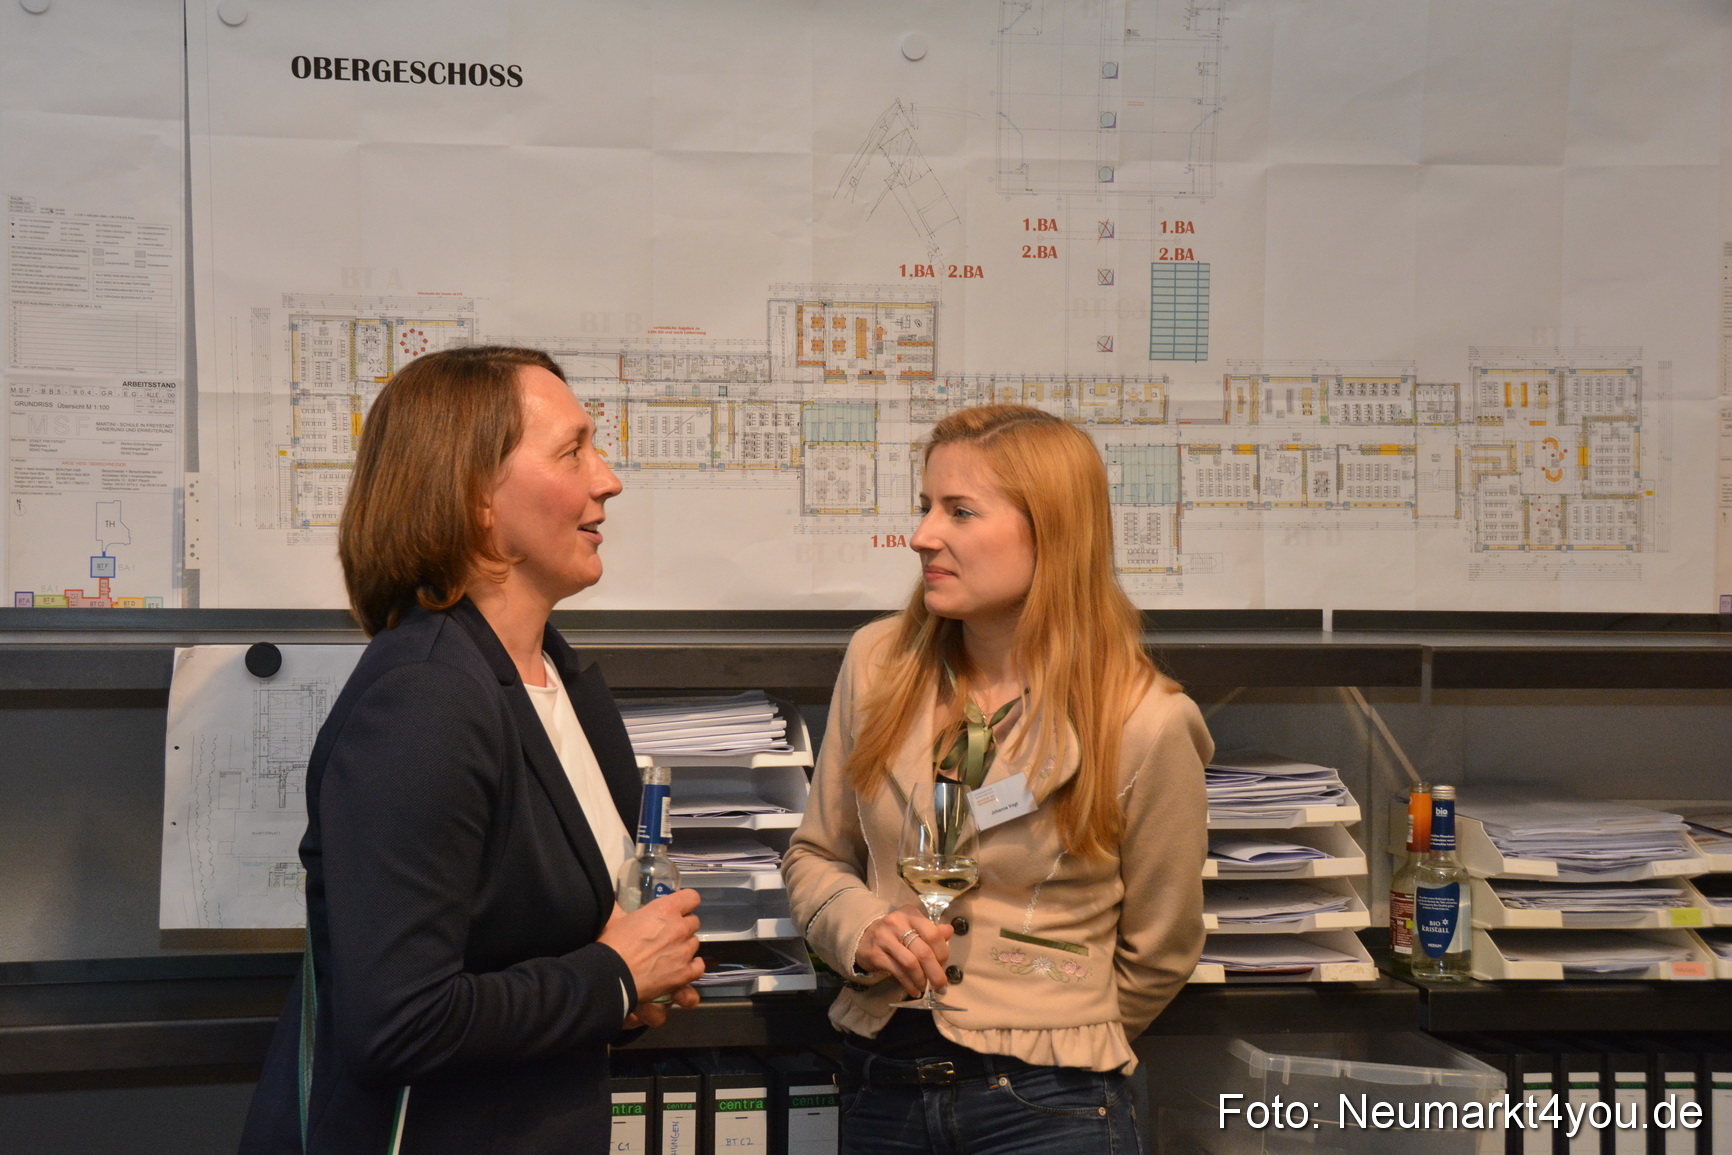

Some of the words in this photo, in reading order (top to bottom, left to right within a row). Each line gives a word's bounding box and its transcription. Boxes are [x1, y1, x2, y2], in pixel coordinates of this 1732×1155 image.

[291, 55, 523, 88] OBERGESCHOSS
[1023, 218, 1058, 231] 1.BA
[1160, 220, 1195, 234] 1.BA
[1022, 245, 1058, 258] 2.BA
[1159, 247, 1195, 261] 2.BA
[899, 264, 935, 277] 1.BA
[948, 264, 984, 278] 2.BA
[57, 402, 85, 410] Übersicht
[105, 520, 116, 528] TH
[871, 535, 907, 547] 1.BA
[1435, 807, 1448, 815] bio
[720, 1099, 763, 1110] centra
[792, 1095, 835, 1106] centra
[612, 1104, 642, 1114] ntra
[617, 1142, 630, 1151] C1
